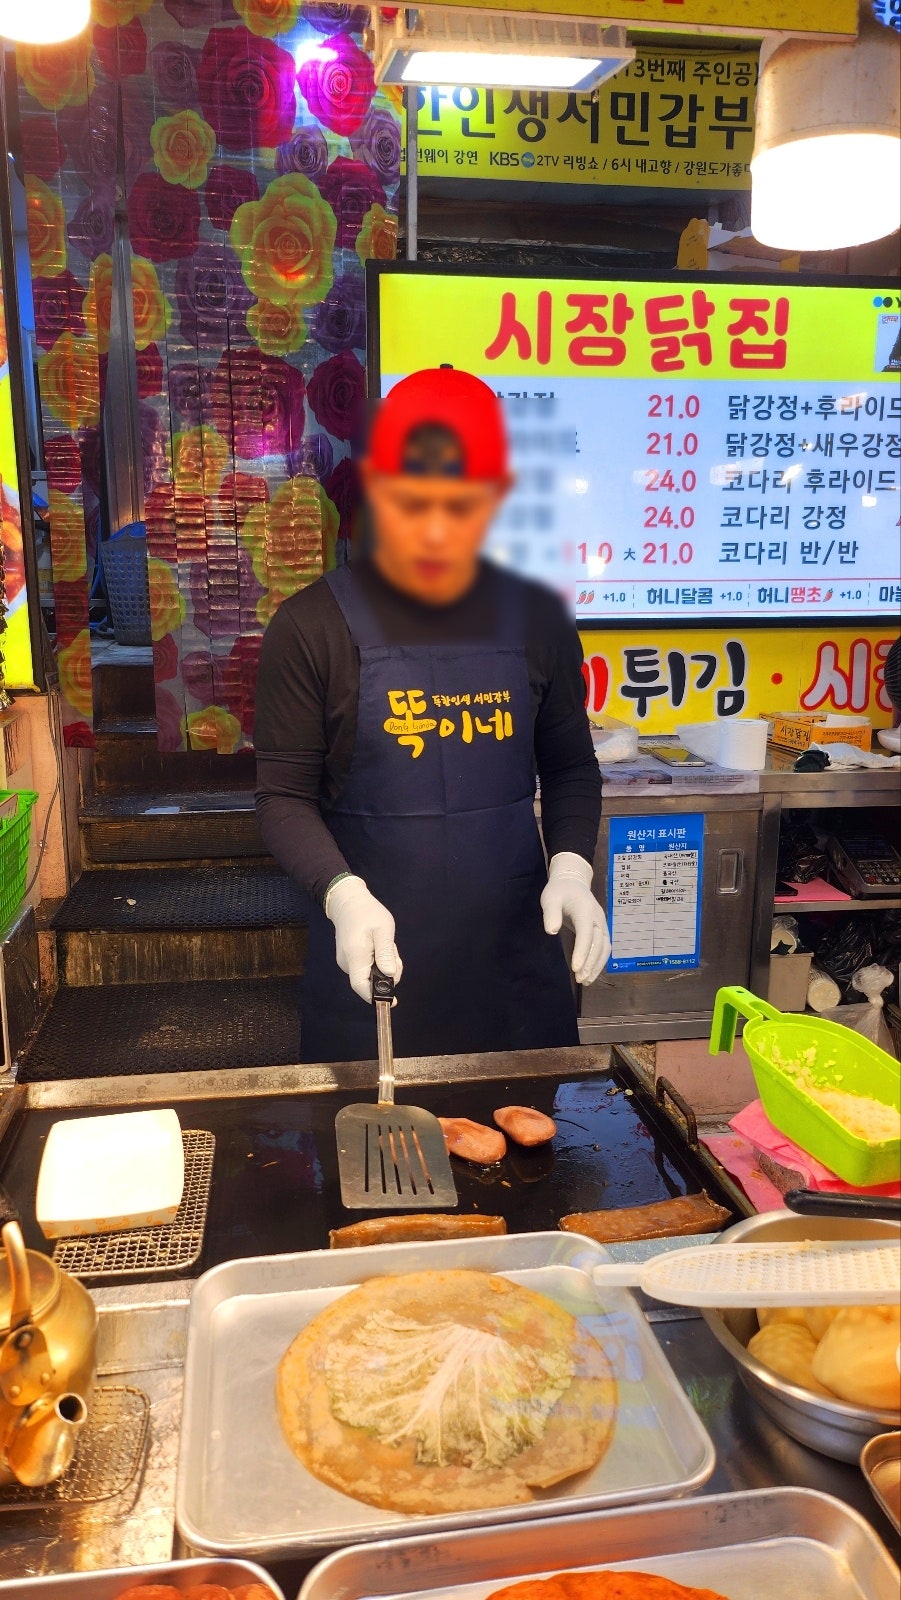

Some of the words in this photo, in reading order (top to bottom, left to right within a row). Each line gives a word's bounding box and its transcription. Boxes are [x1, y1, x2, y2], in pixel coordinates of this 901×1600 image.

[453, 149, 478, 165] 강연
[489, 151, 520, 167] KBS
[536, 155, 560, 167] 2TV
[563, 155, 599, 171] 리빙쇼
[611, 158, 631, 173] 6시
[635, 158, 672, 175] 내고향
[484, 290, 790, 373] 시장닭집
[647, 394, 700, 420] 21.0
[727, 394, 901, 421] 닭강정+후라이드
[646, 432, 699, 457] 21.0
[644, 469, 697, 493] 24.0
[721, 468, 792, 494] 코다리
[803, 468, 897, 494] 후라이드
[643, 506, 695, 530] 24.0
[719, 505, 790, 530] 코다리
[802, 505, 847, 531] 강정
[642, 542, 694, 566] 21.0
[718, 541, 788, 566] 코다리
[799, 540, 860, 566] 반/반
[602, 591, 626, 603] +1.0
[646, 586, 713, 605] 허니달콤
[719, 591, 743, 602] +1.0
[756, 585, 822, 604] 허니땡초
[839, 589, 862, 601] +1.0
[620, 640, 746, 718] 튀김
[626, 829, 656, 841] 원산지
[657, 827, 687, 839] 표시판
[668, 842, 688, 851] 원산지
